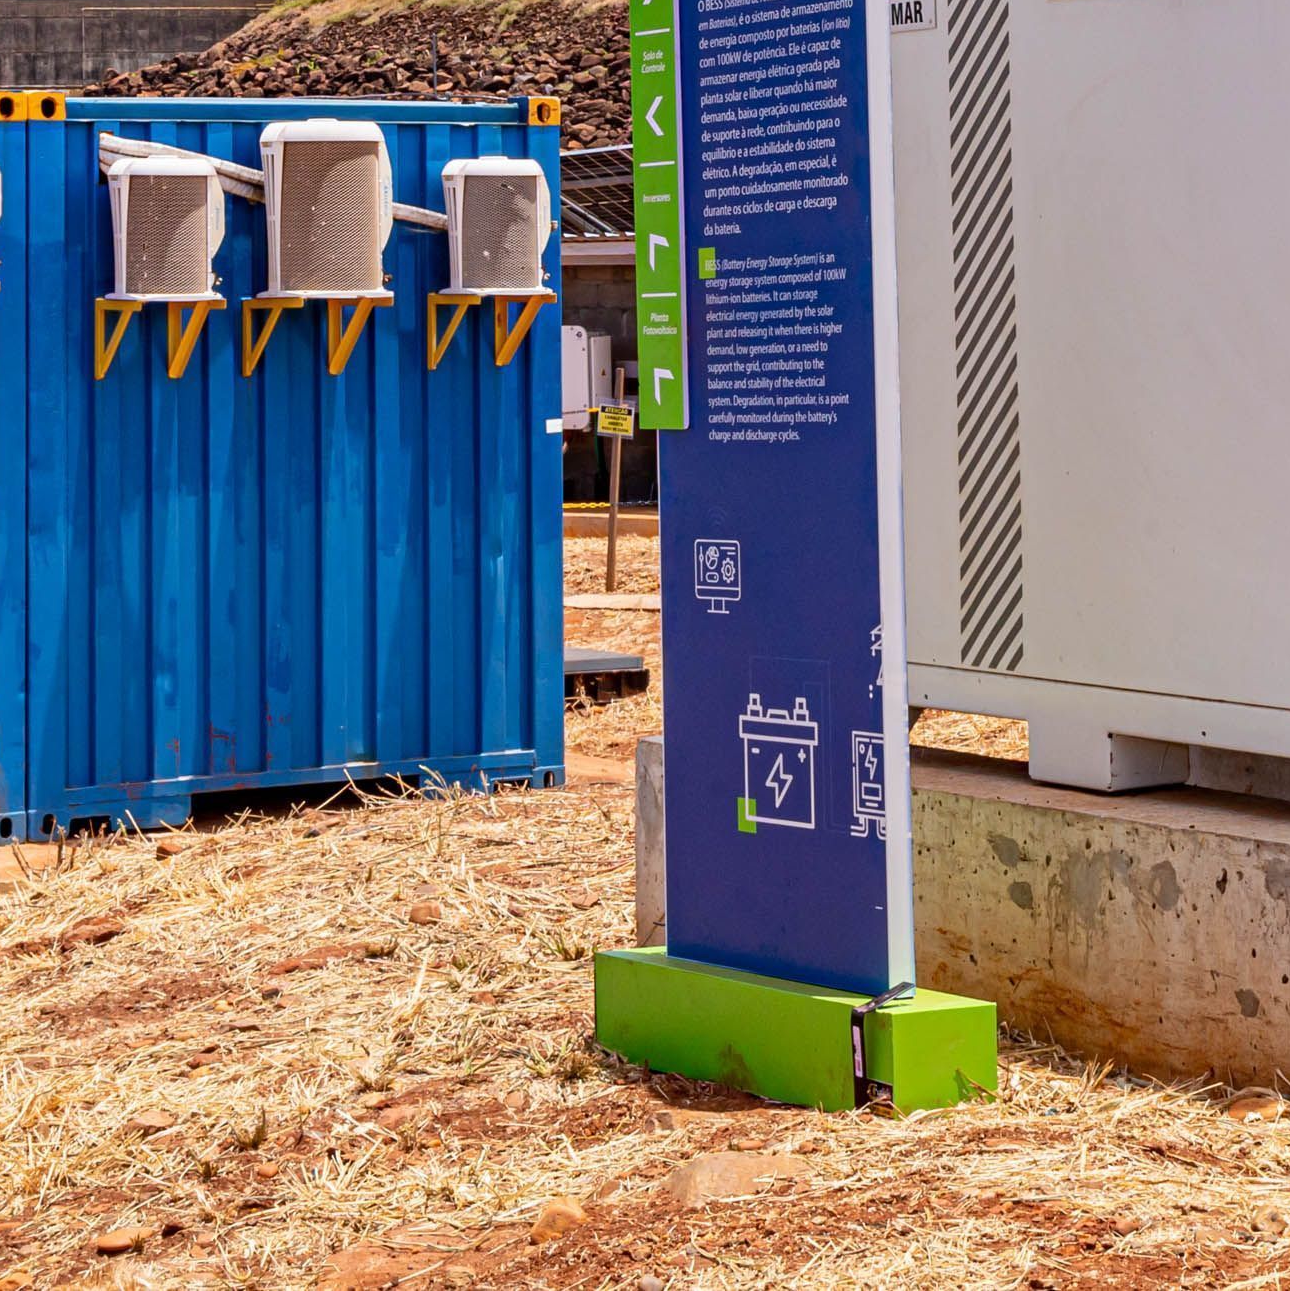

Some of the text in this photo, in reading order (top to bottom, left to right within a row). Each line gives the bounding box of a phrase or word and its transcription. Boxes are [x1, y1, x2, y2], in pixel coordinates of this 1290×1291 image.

[698, 22, 708, 31] em
[752, 10, 779, 23] sistema
[781, 6, 790, 18] de
[891, 1, 923, 25] MAR
[699, 38, 709, 49] de
[710, 33, 737, 48] energia
[738, 29, 775, 44] composto
[776, 28, 789, 41] por
[790, 21, 820, 36] baterias
[699, 58, 715, 68] com
[717, 51, 741, 65] 100kW
[742, 50, 752, 62] de
[753, 45, 788, 64] potência.
[789, 43, 800, 56] Ele
[807, 41, 829, 54] capaz
[830, 37, 841, 49] de
[700, 56, 840, 87] armazenar energia elétrica gerada pela
[701, 93, 723, 108] planta
[725, 89, 742, 103] solar
[749, 86, 773, 99] liberar
[774, 81, 803, 99] quando
[804, 79, 814, 91] há
[815, 77, 837, 90] maior
[701, 94, 847, 124] demanda, baixa geração ou necessidade
[701, 130, 711, 142] de
[712, 129, 740, 144] suporte
[747, 124, 766, 137] rede,
[767, 118, 815, 135] contribuindo
[816, 119, 833, 132] para
[749, 140, 794, 156] estabilidade
[795, 139, 806, 151] do
[807, 138, 835, 150] sistema
[702, 167, 731, 180] elétrico.
[739, 161, 784, 179] degradação,
[785, 162, 797, 172] em
[798, 155, 830, 172] especial,
[705, 173, 848, 200] um ponto cuidadosamente monitorado
[703, 205, 732, 217] durante
[733, 205, 742, 215] os
[743, 201, 763, 214] ciclos
[764, 200, 774, 212] de
[775, 200, 796, 213] carga
[803, 196, 837, 210] descarga
[704, 222, 741, 236] da bateria.
[705, 268, 846, 290] energy storage system composed of 100kW
